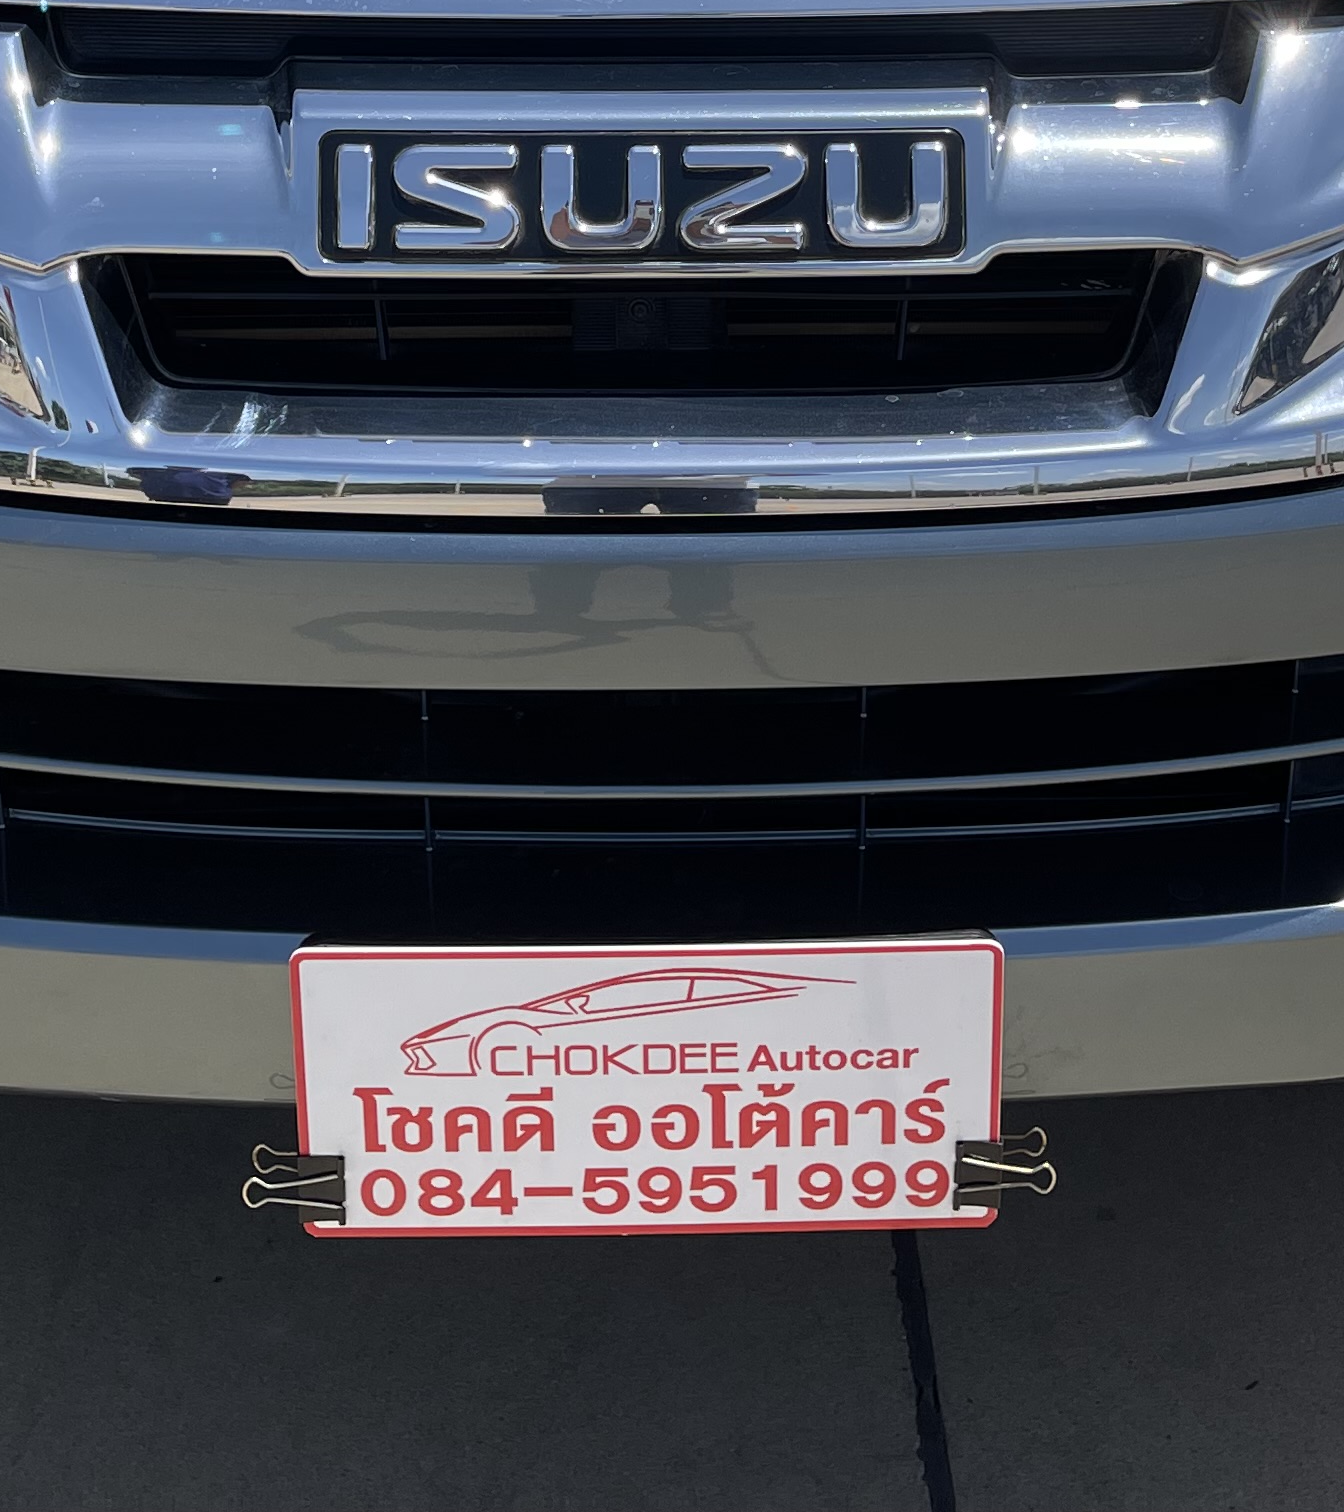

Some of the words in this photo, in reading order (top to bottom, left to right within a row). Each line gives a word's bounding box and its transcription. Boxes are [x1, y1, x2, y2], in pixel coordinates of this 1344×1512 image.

[335, 143, 948, 251] ISUZU
[489, 1042, 739, 1077] CHOKDEE
[747, 1043, 920, 1075] Autocar
[353, 1086, 555, 1154] โชคดี
[591, 1078, 950, 1152] ออโต้คาร์
[360, 1159, 950, 1217] 084-5951999
